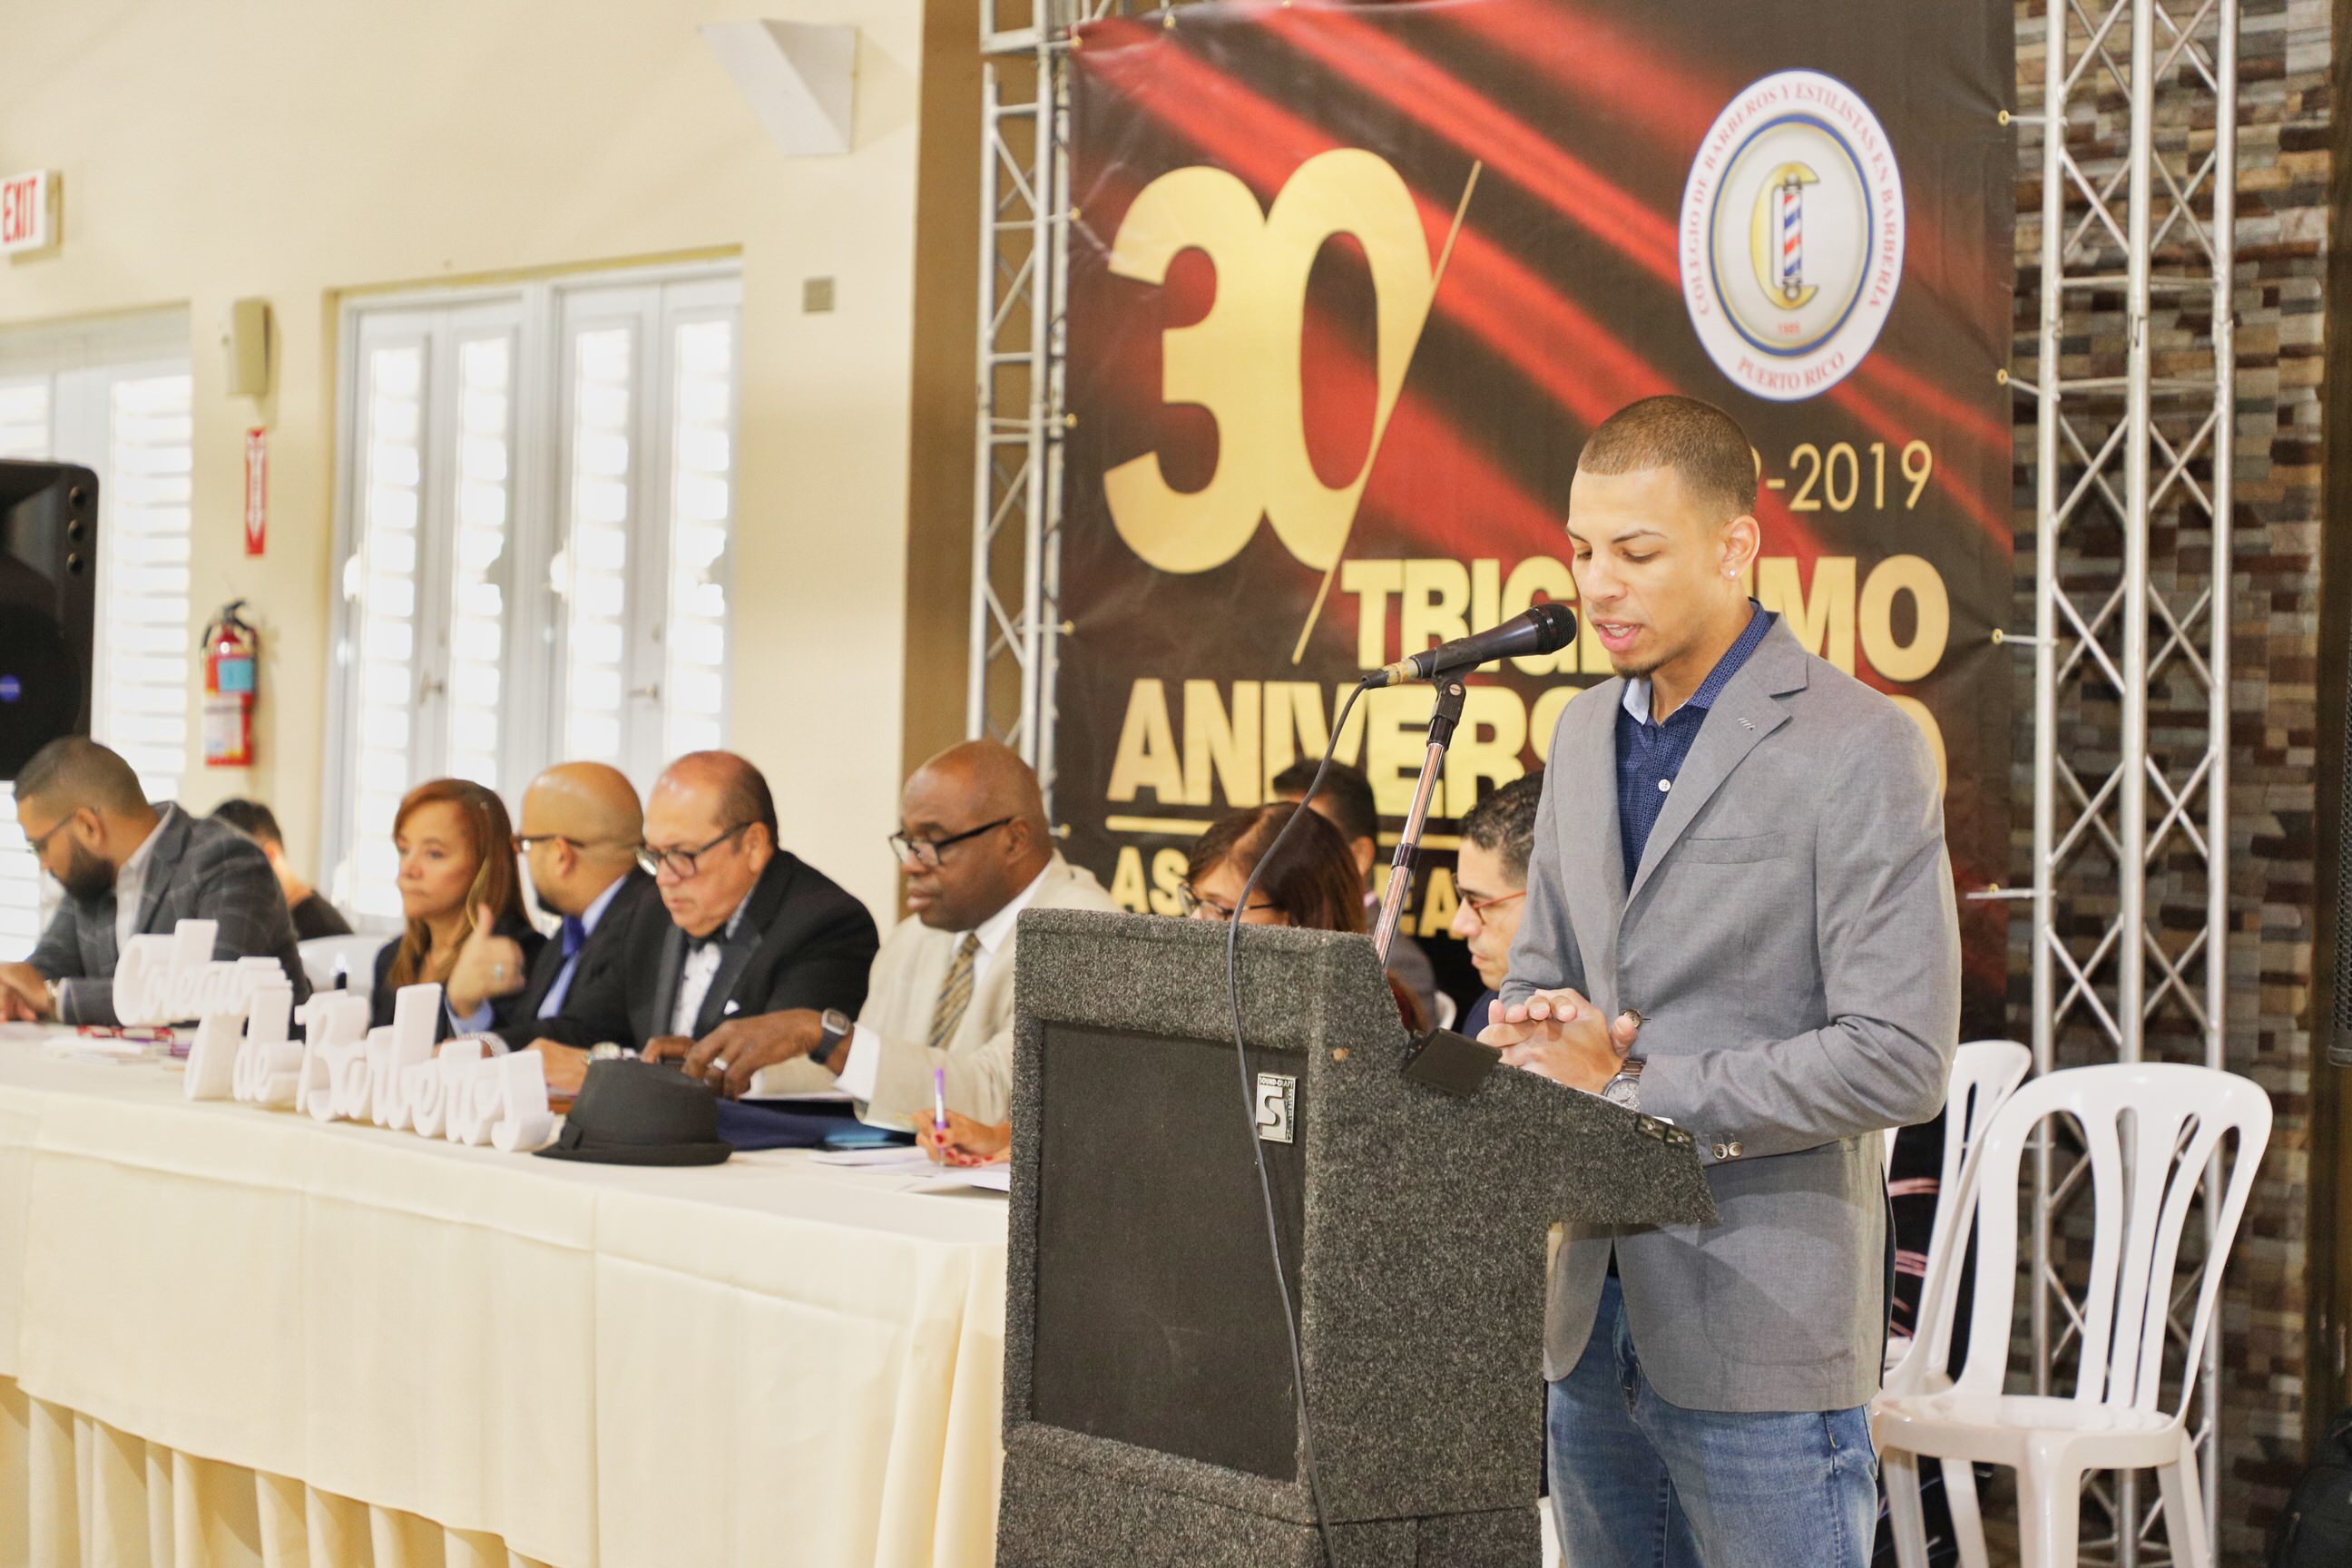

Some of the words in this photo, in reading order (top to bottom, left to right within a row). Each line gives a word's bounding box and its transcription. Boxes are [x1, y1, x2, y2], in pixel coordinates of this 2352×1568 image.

[1705, 90, 1779, 171] BARBEROS
[1795, 82, 1877, 152] ESTILISTAS
[3, 177, 36, 243] EXIT
[1103, 147, 1432, 573] 30
[1737, 357, 1800, 390] PUERTO
[1804, 351, 1845, 382] RICO
[1750, 439, 1933, 513] -2019
[1340, 555, 1950, 682] TRIGMO
